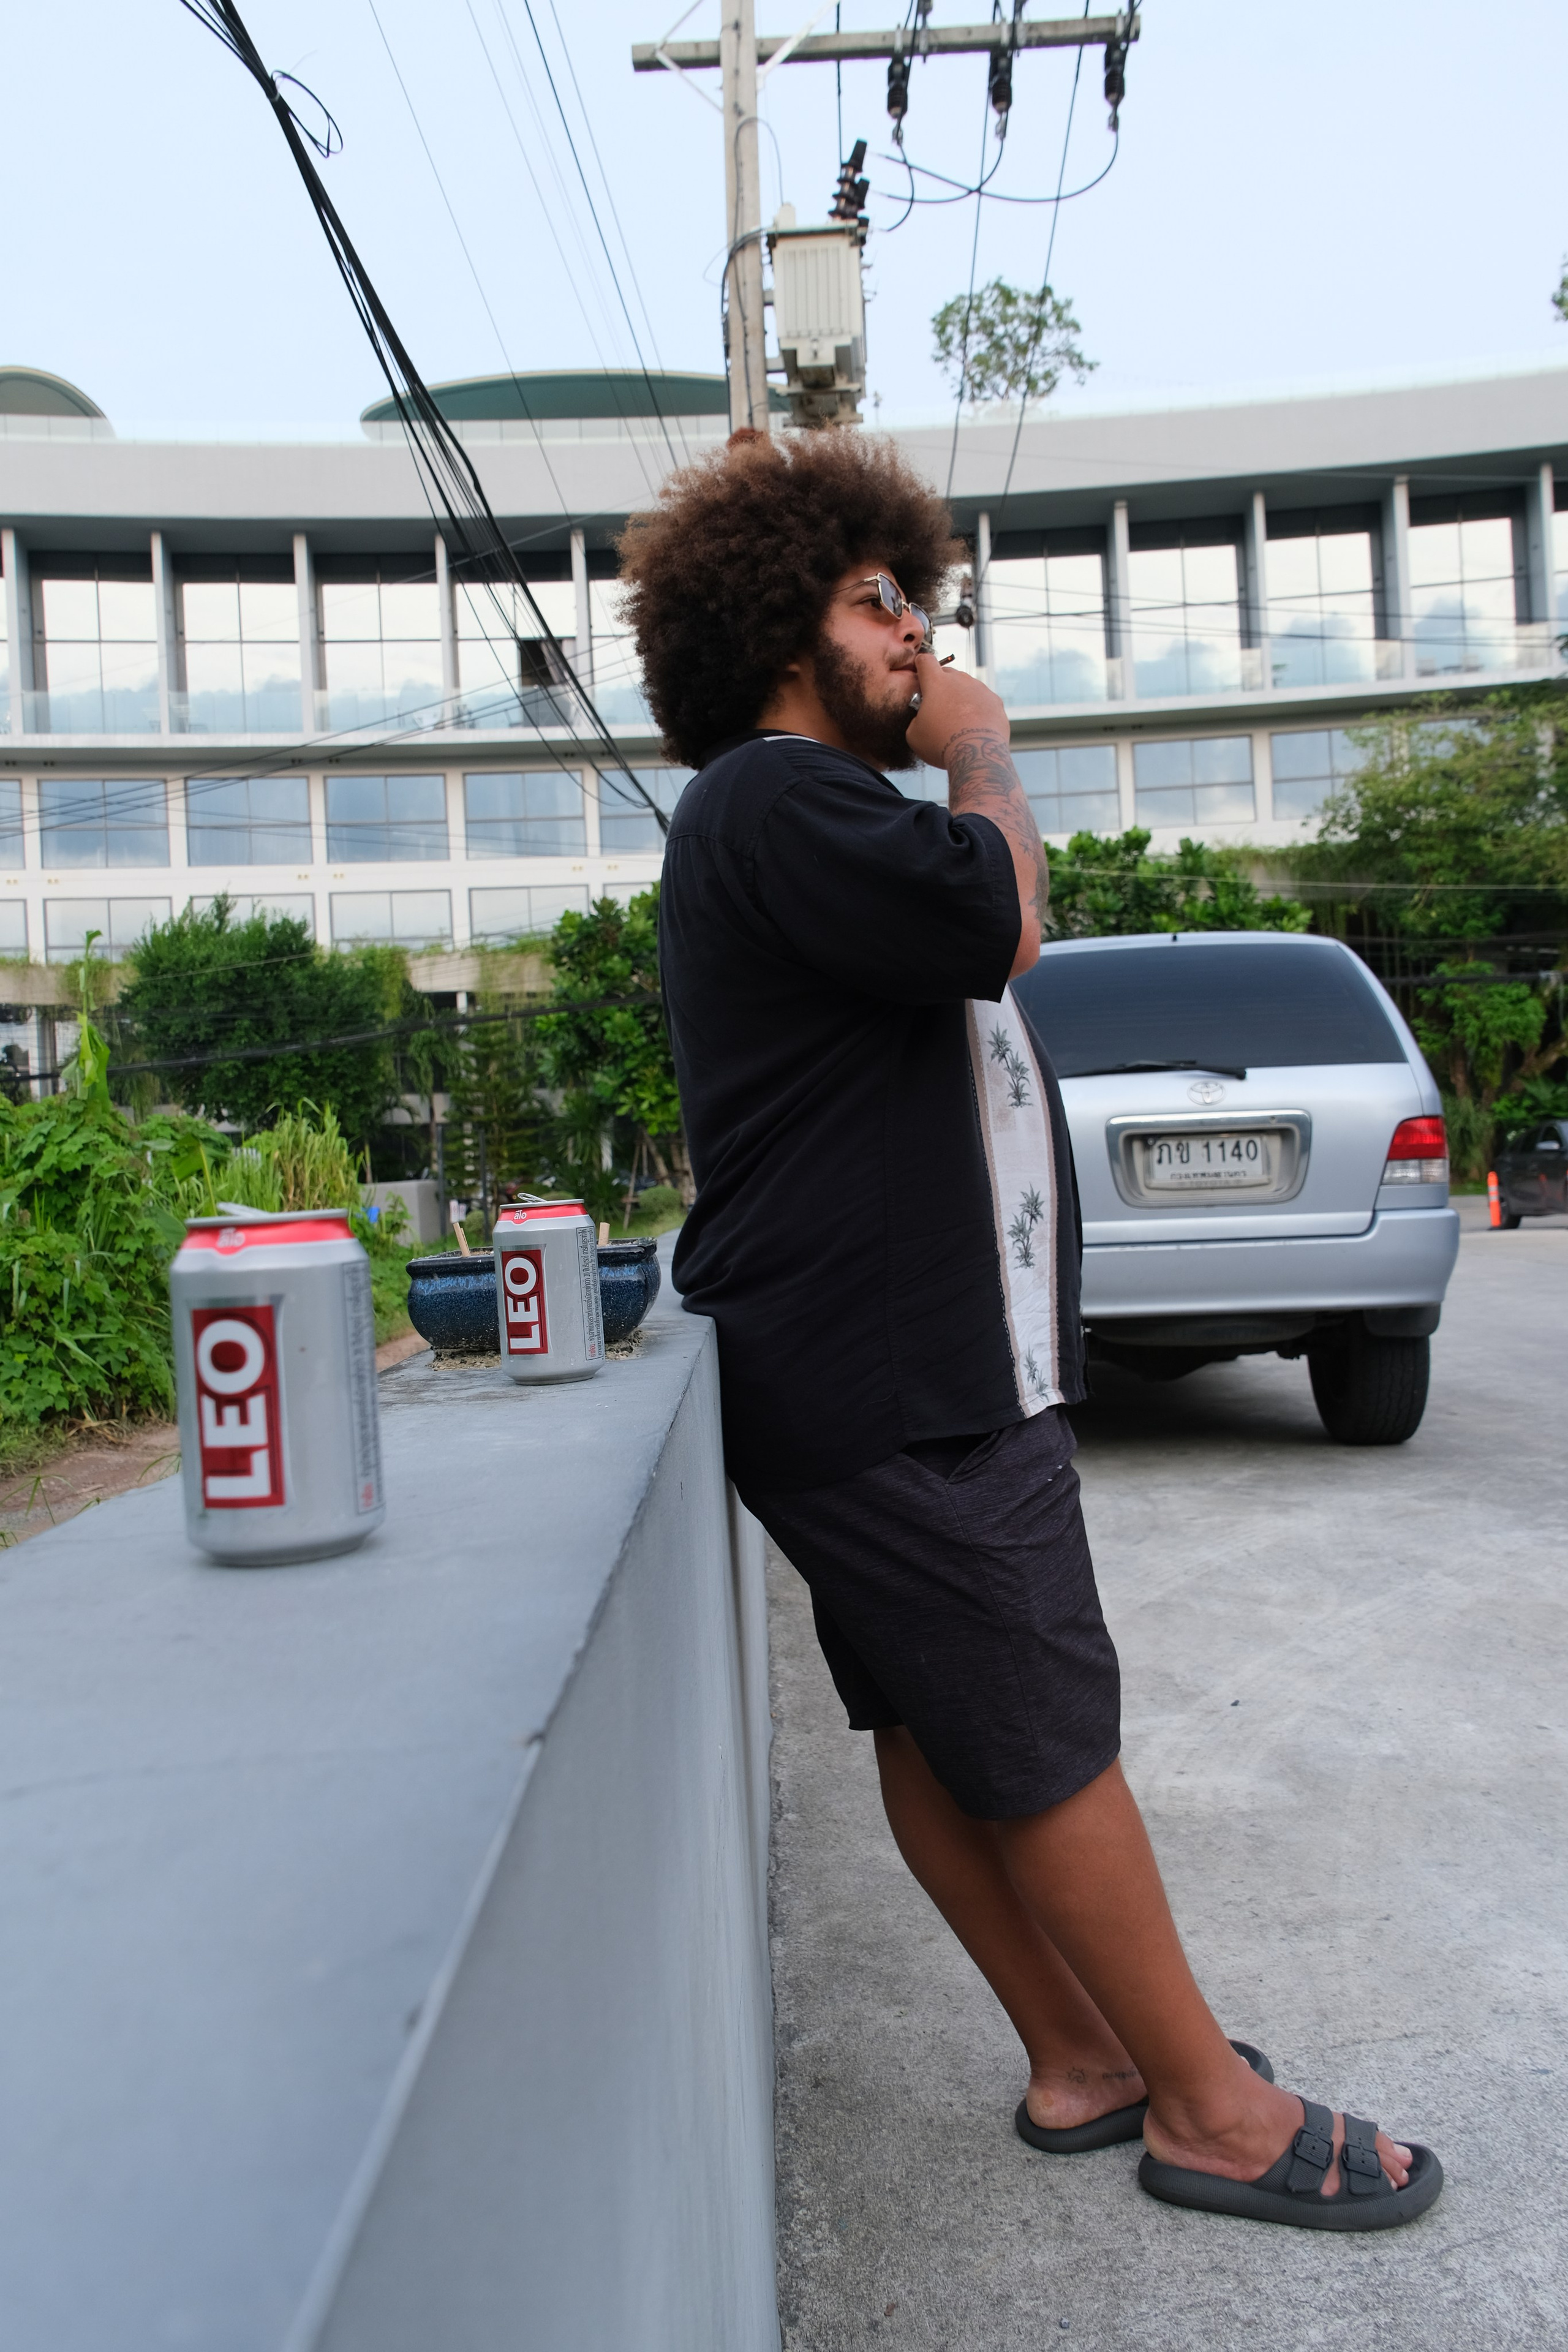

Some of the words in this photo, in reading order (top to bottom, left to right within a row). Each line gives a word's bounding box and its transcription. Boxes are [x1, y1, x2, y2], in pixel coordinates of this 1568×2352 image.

[1157, 1142, 1189, 1164] ภข
[1202, 1139, 1258, 1163] 1140
[514, 1209, 527, 1219] ลีโอ
[505, 1257, 541, 1349] LEO
[197, 1318, 272, 1499] LEO
